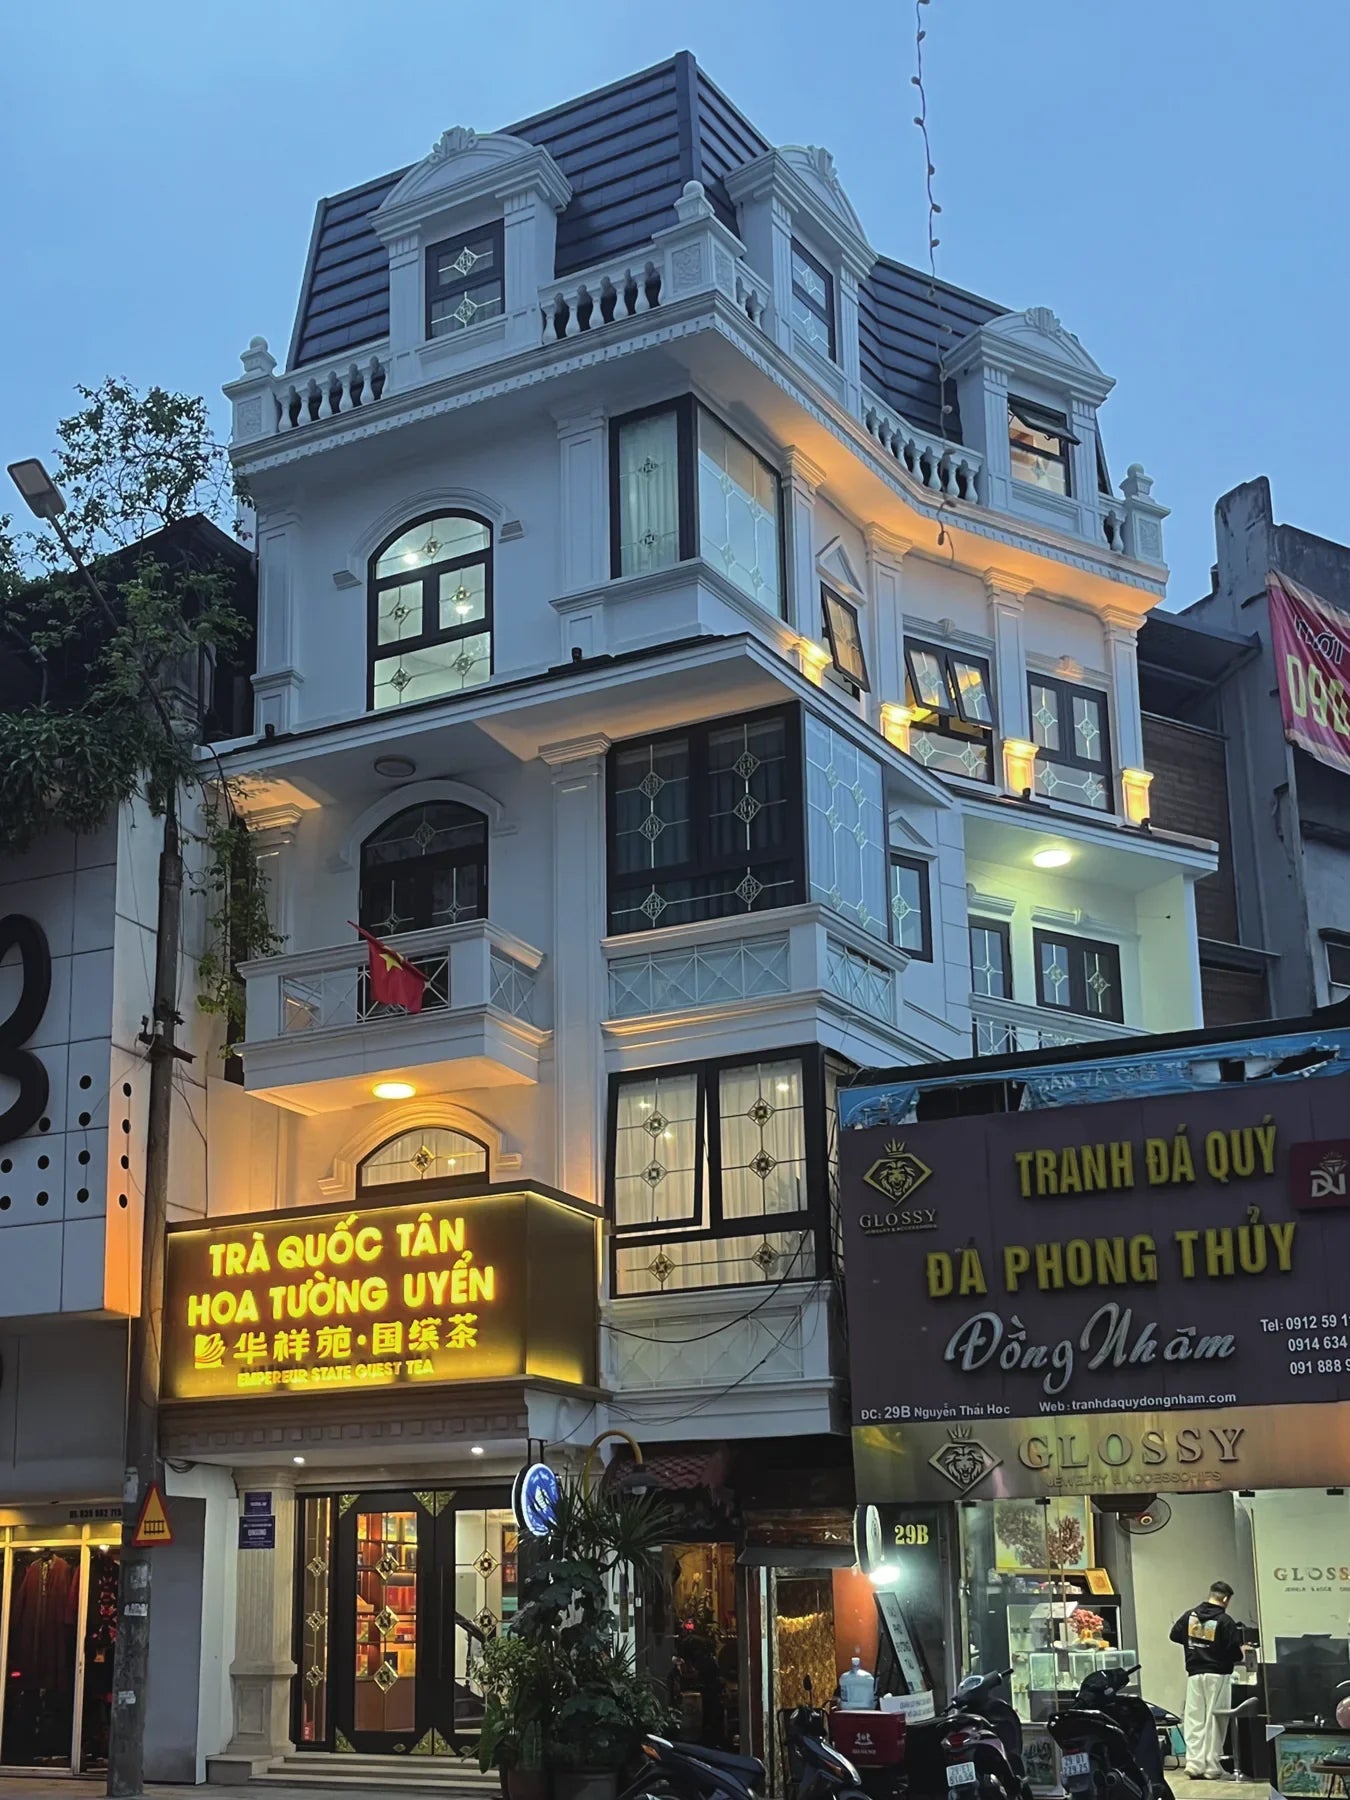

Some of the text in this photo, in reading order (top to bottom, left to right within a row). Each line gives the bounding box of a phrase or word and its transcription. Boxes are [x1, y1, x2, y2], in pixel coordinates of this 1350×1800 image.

[1015, 1114, 1276, 1197] TRANH ĐÁ QUÝ
[859, 1208, 936, 1228] GLOSSY
[209, 1212, 465, 1277] TRÀ QUỐC TÂN
[1004, 1234, 1158, 1292] PHONG
[1175, 1204, 1296, 1278] THỦY
[188, 1250, 495, 1326] HOA TƯỜNG UYỂN
[1286, 1315, 1318, 1330] 0912
[1321, 1314, 1337, 1328] 59
[944, 1311, 1074, 1395] Đồng
[1288, 1335, 1348, 1352] 0914 634
[310, 1365, 351, 1382] STATE
[355, 1361, 402, 1378] GUEST
[406, 1359, 434, 1375] TEA
[1290, 1361, 1312, 1375] 091
[1317, 1359, 1342, 1373] 888
[884, 1405, 911, 1419] 29B
[1072, 1393, 1237, 1410] tranhdaquydongnham.com
[1018, 1428, 1245, 1470] GLOSSY
[1047, 1474, 1108, 1488] JEWELRY
[894, 1524, 929, 1545] 29B
